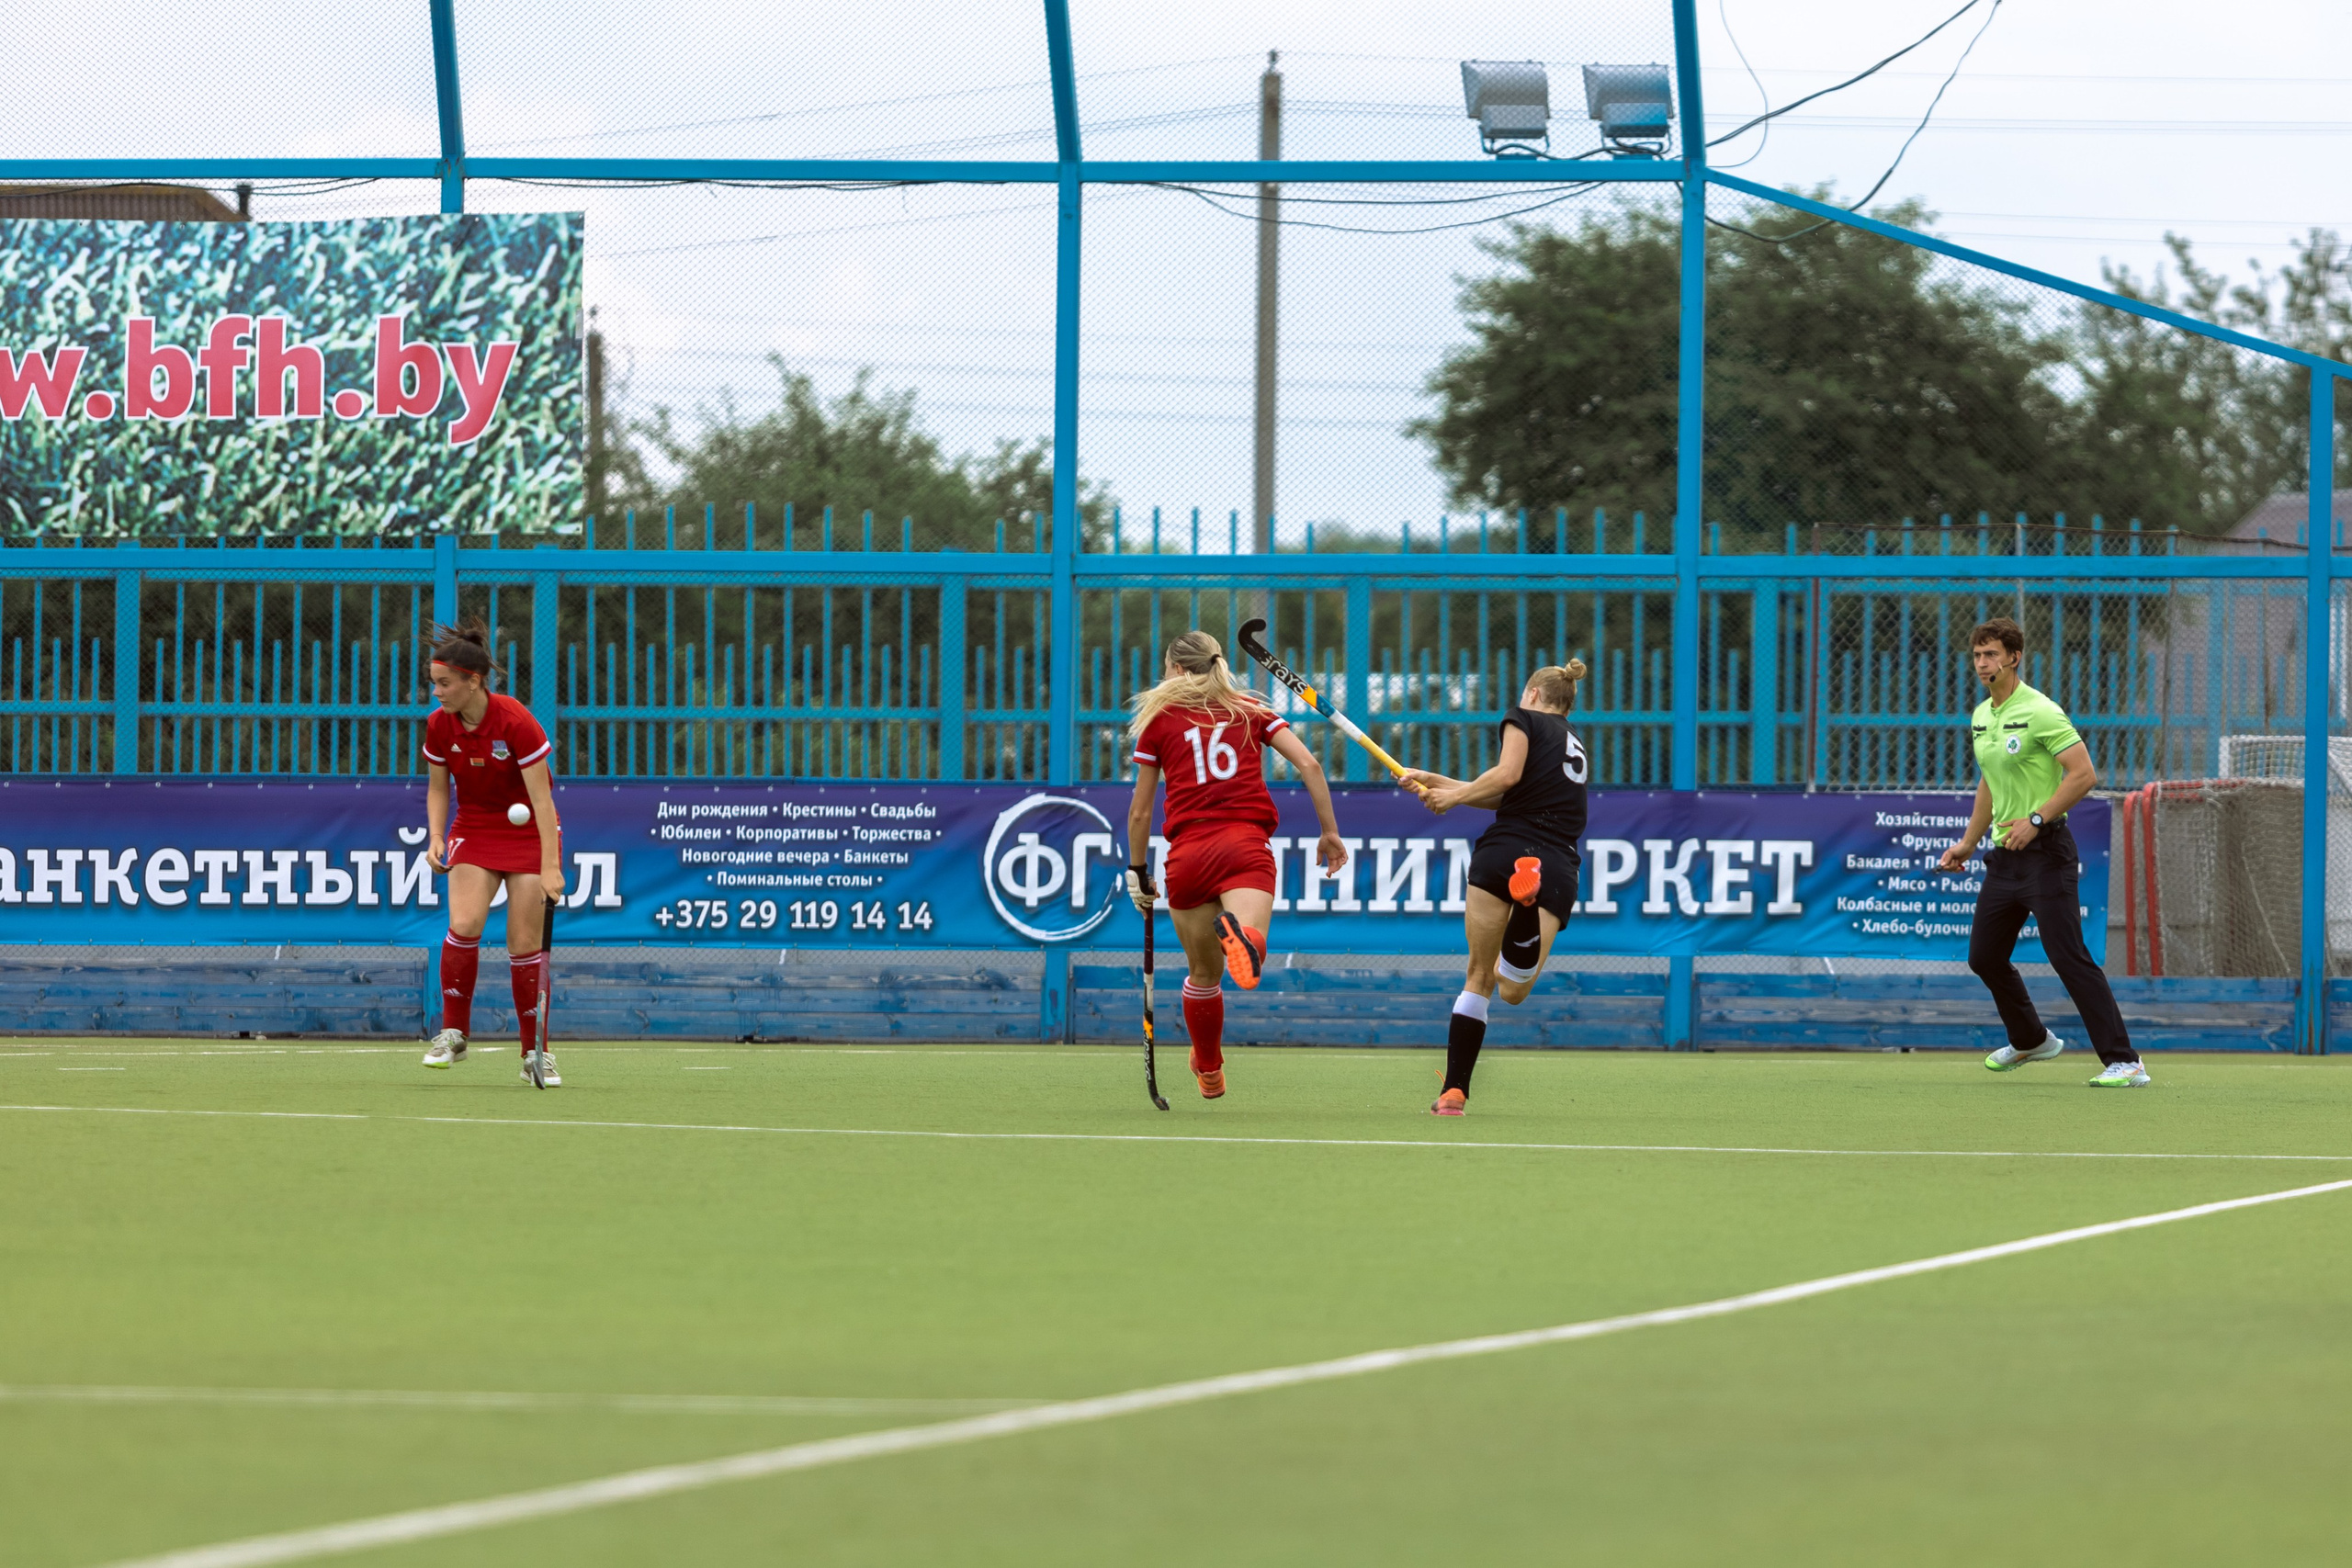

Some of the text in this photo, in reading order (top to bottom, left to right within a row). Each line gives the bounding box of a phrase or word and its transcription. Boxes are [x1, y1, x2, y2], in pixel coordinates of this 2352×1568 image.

[1183, 721, 1238, 785] 16
[1562, 729, 1588, 784] 5
[657, 801, 936, 820] Дни рождения Крестины Свадьбы
[661, 824, 932, 843] Юбилеи Корпоративы Торжества
[682, 848, 909, 866] Новогодние вечера Банкеты
[1847, 854, 1910, 870] Бакалея
[718, 871, 873, 886] Поминальные столы
[998, 832, 1112, 908] ФГ
[1888, 876, 1982, 893] Мясо Рыба
[1838, 897, 1923, 913] Колбасные
[1927, 901, 1937, 913] и
[655, 899, 933, 931] +375 29 119 14 14
